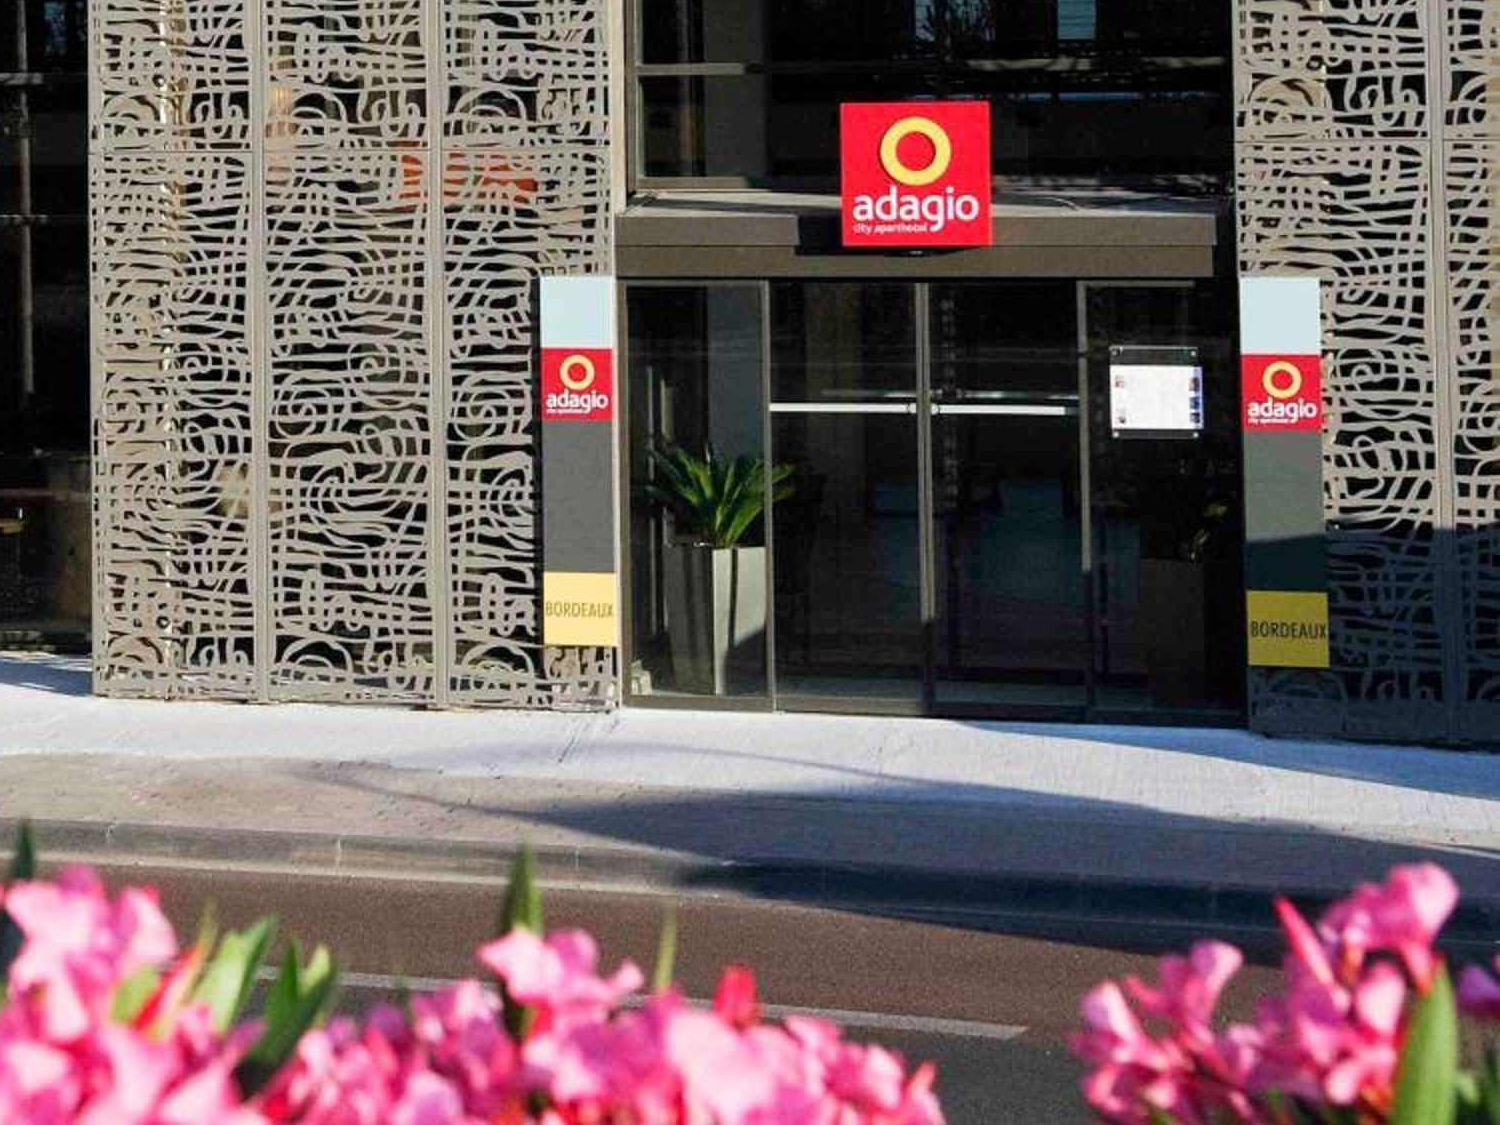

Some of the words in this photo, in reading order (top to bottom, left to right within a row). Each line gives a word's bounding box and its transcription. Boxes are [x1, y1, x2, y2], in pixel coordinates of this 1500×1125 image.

[853, 184, 980, 233] adagio
[547, 388, 609, 414] adagio
[1247, 396, 1317, 424] adagio
[545, 601, 613, 618] BORDEAUX
[1251, 620, 1327, 639] BORDEAUX
